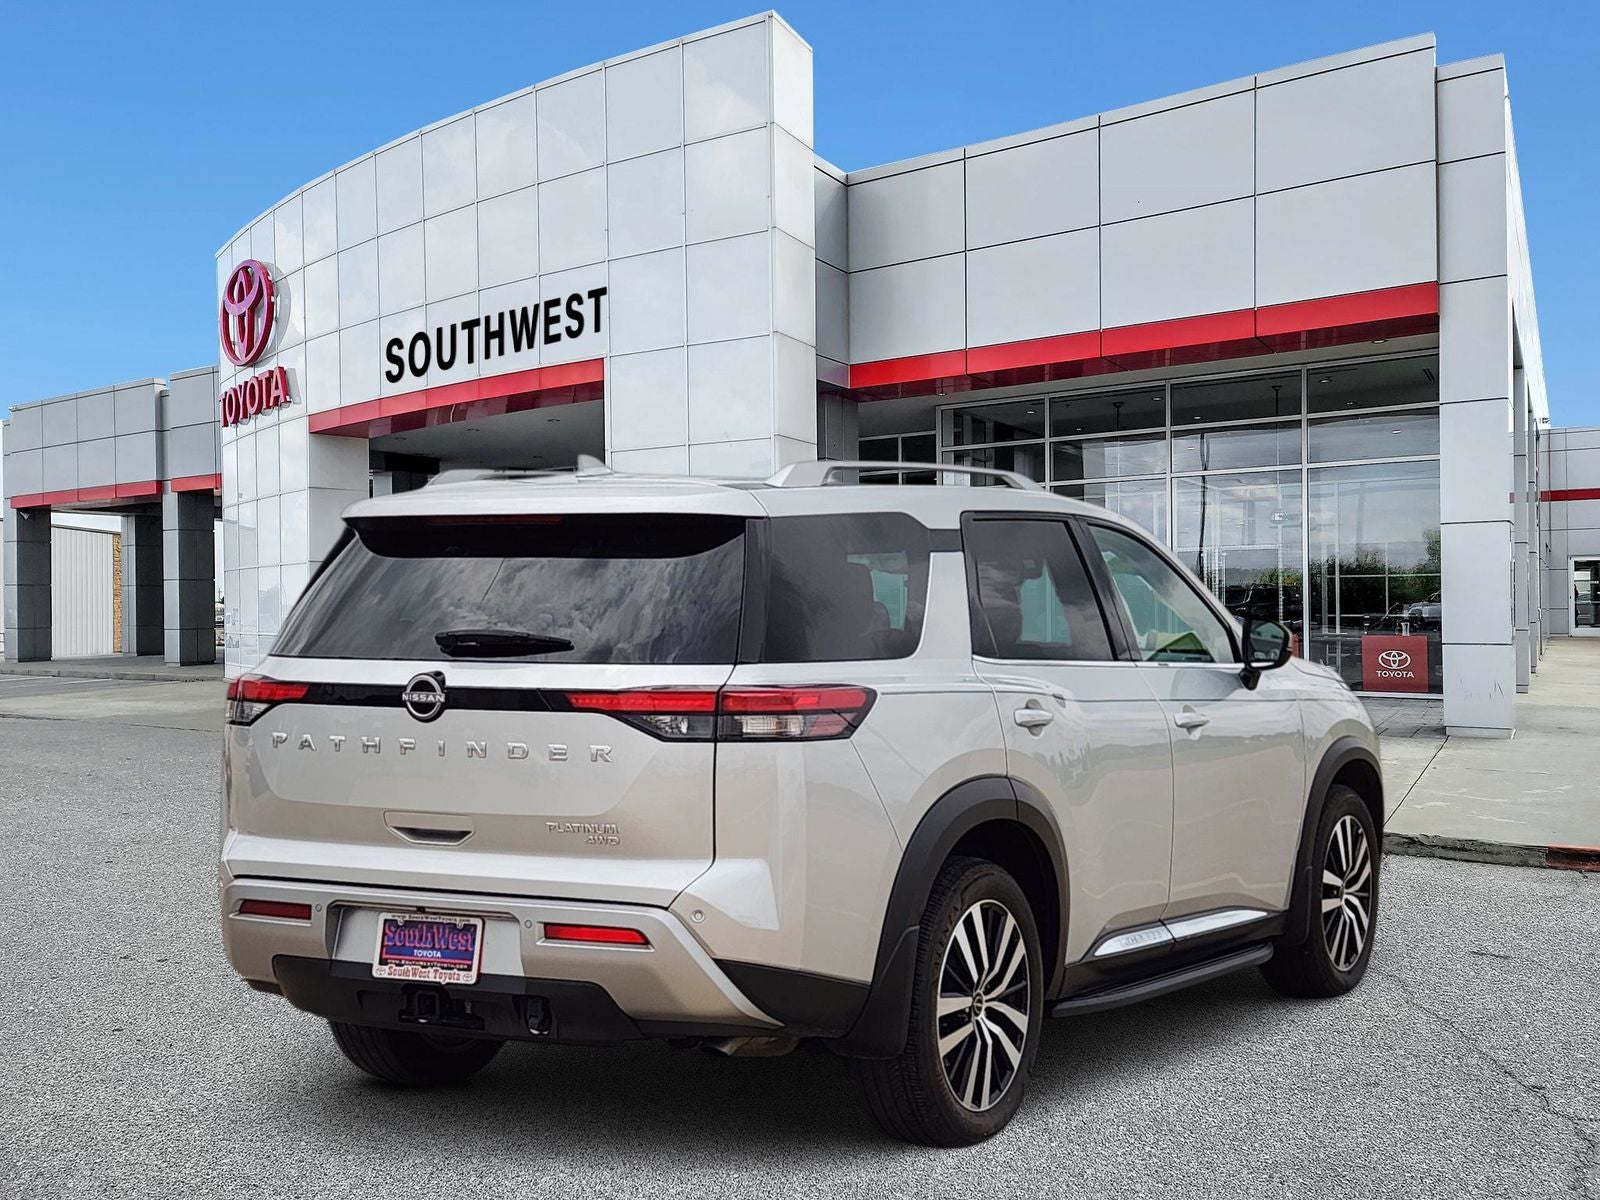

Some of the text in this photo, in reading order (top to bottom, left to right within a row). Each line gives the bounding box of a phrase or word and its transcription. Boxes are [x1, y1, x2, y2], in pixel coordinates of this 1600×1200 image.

[385, 286, 608, 384] SOUTHWEST
[218, 366, 289, 428] TOYOTA
[1376, 670, 1415, 679] TOYOTA
[402, 692, 446, 703] NISSAN
[271, 731, 614, 763] PATHFINDER
[545, 821, 619, 835] PLATINUM
[585, 835, 620, 846] AWD
[413, 949, 442, 958] TOYOTA
[433, 969, 461, 982] Toyota
